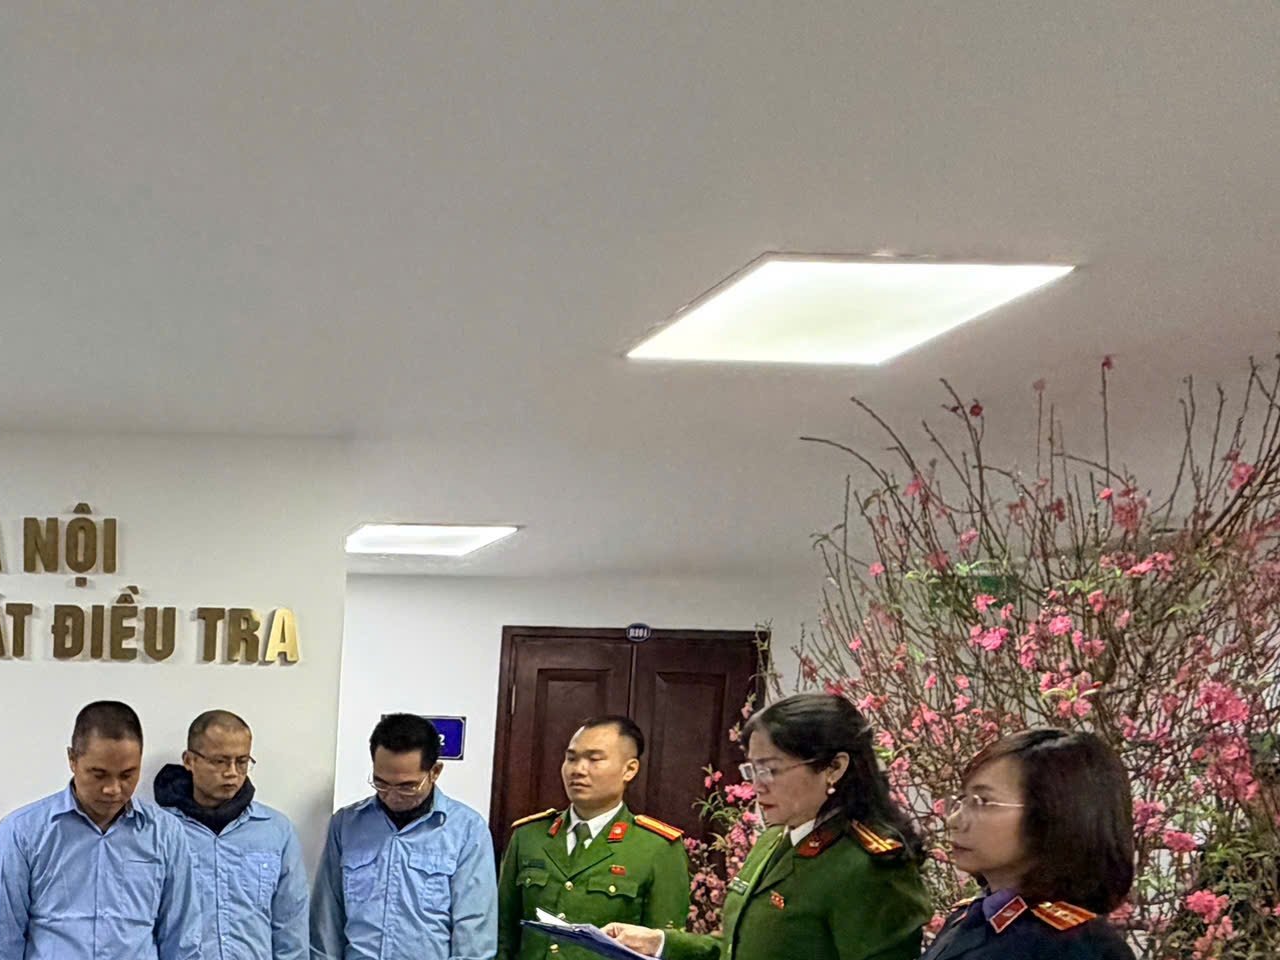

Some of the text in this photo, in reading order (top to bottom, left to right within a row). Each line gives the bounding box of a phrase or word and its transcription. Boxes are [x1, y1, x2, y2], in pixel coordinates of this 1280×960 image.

[23, 502, 117, 587] NỘI
[51, 585, 176, 663] ĐIỀU
[197, 606, 301, 664] TRA
